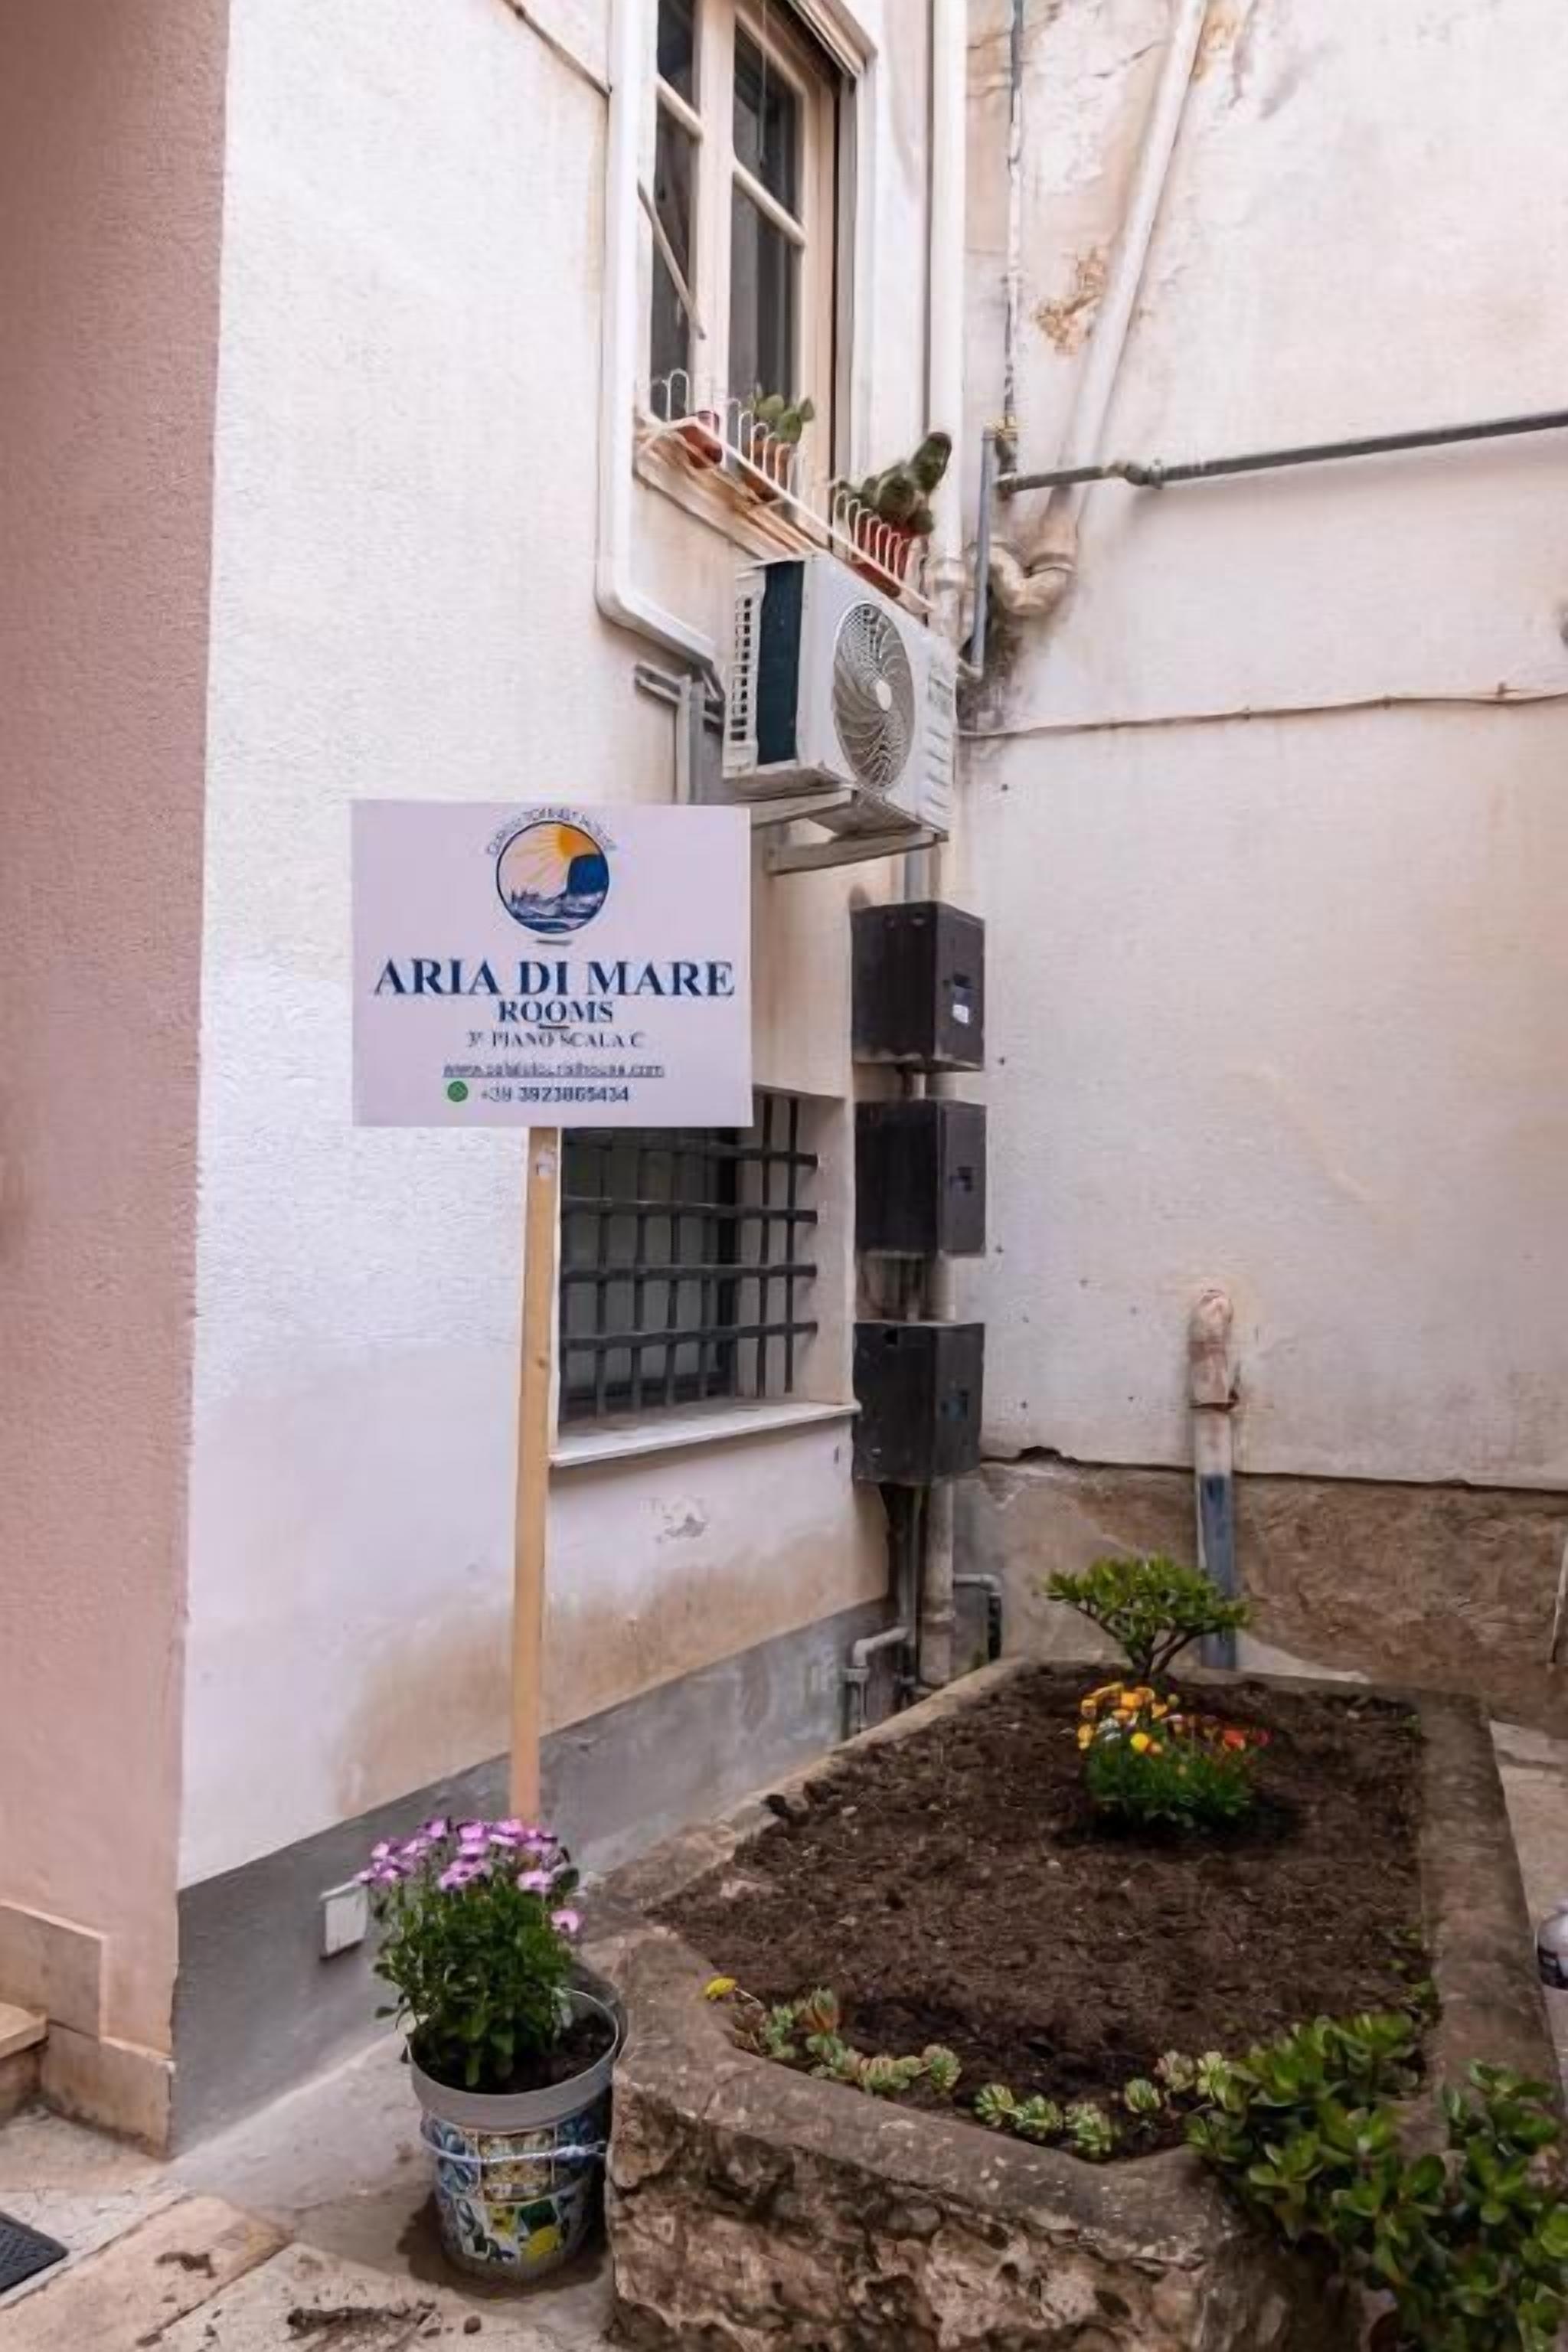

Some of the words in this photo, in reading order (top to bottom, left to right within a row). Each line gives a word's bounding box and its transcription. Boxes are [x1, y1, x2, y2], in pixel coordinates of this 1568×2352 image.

[374, 959, 501, 995] ARIA
[519, 960, 569, 995] DI
[587, 960, 735, 996] MARE
[498, 1000, 613, 1024] ROOMS
[560, 1032, 626, 1047] SCALA
[630, 1032, 645, 1047] C
